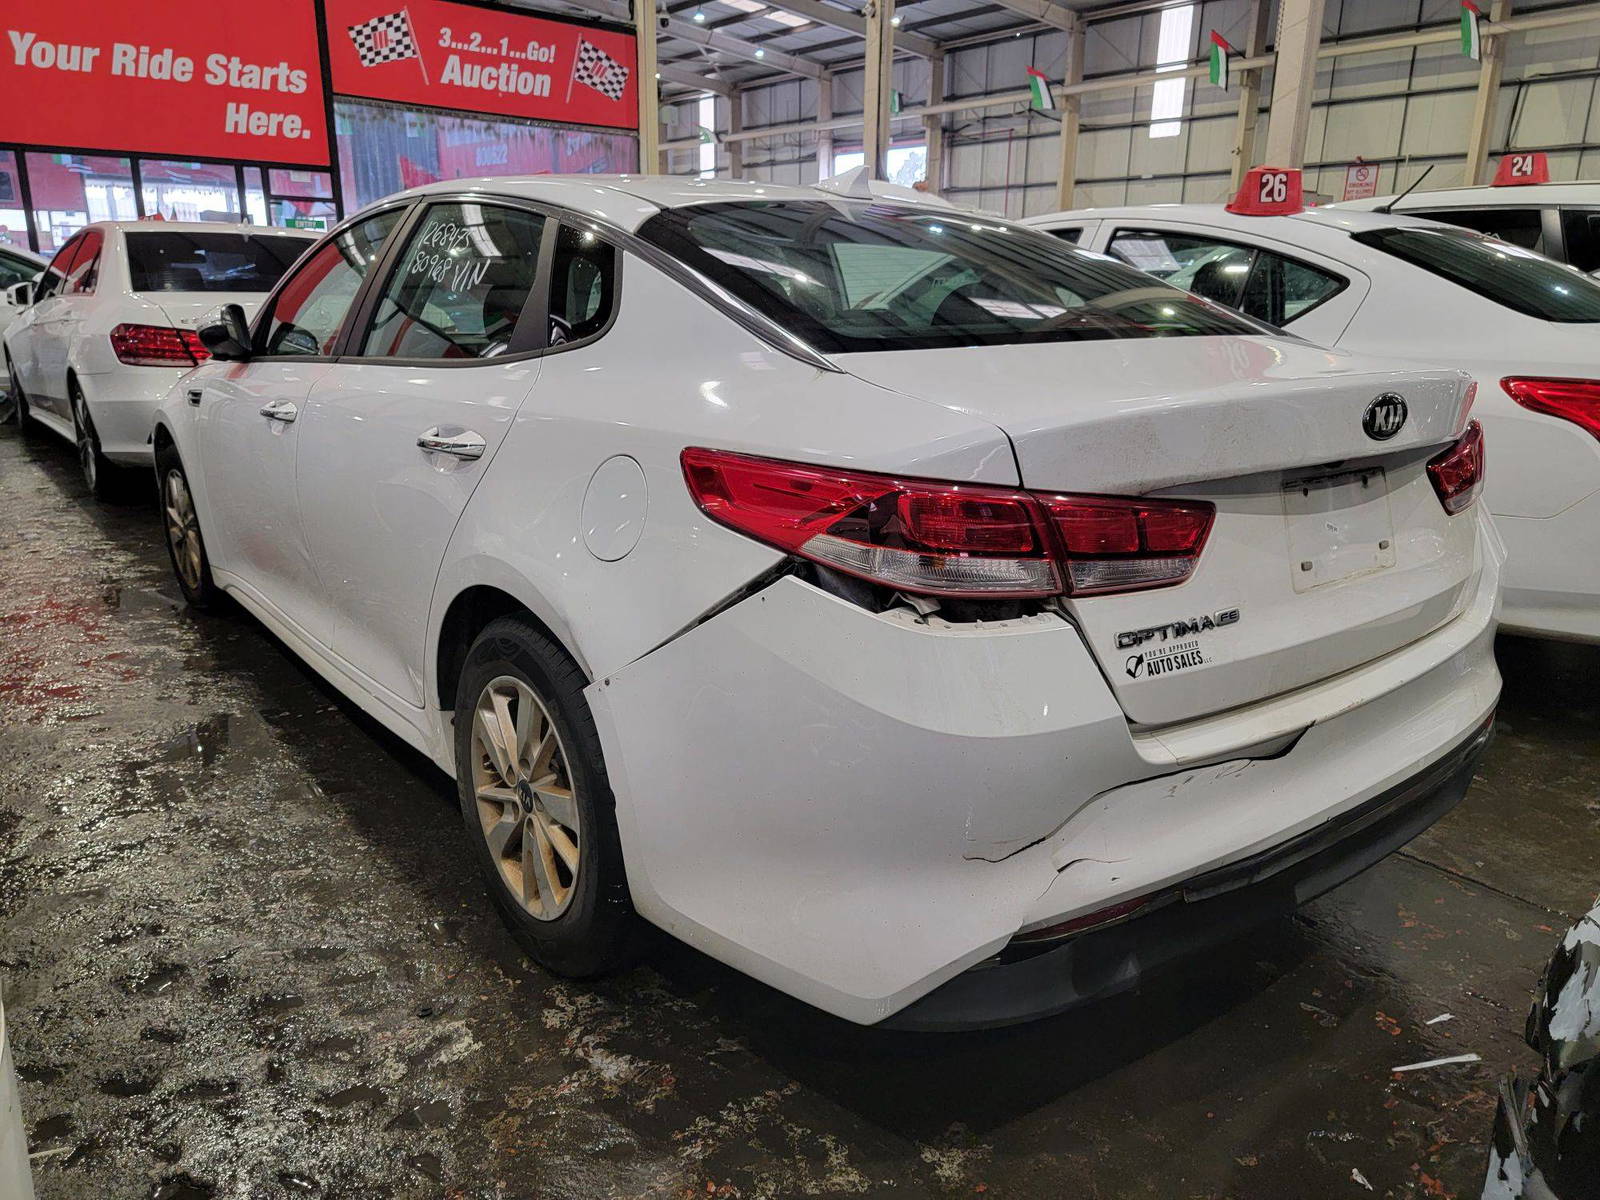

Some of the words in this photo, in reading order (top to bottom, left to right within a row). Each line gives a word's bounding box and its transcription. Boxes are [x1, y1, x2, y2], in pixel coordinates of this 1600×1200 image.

[7, 30, 100, 73] Your
[110, 42, 194, 82] Ride
[204, 53, 308, 94] Starts
[440, 55, 551, 97] Auction
[224, 102, 312, 140] Here.
[1511, 155, 1533, 177] 24
[1260, 173, 1288, 203] 26
[451, 258, 491, 292] VIN
[1373, 403, 1404, 432] KIA
[1114, 614, 1216, 651] OPTIMA
[1220, 610, 1239, 622] FE
[1168, 640, 1199, 653] APPROVED
[1147, 656, 1174, 677] AUTO
[1174, 650, 1204, 670] SALES
